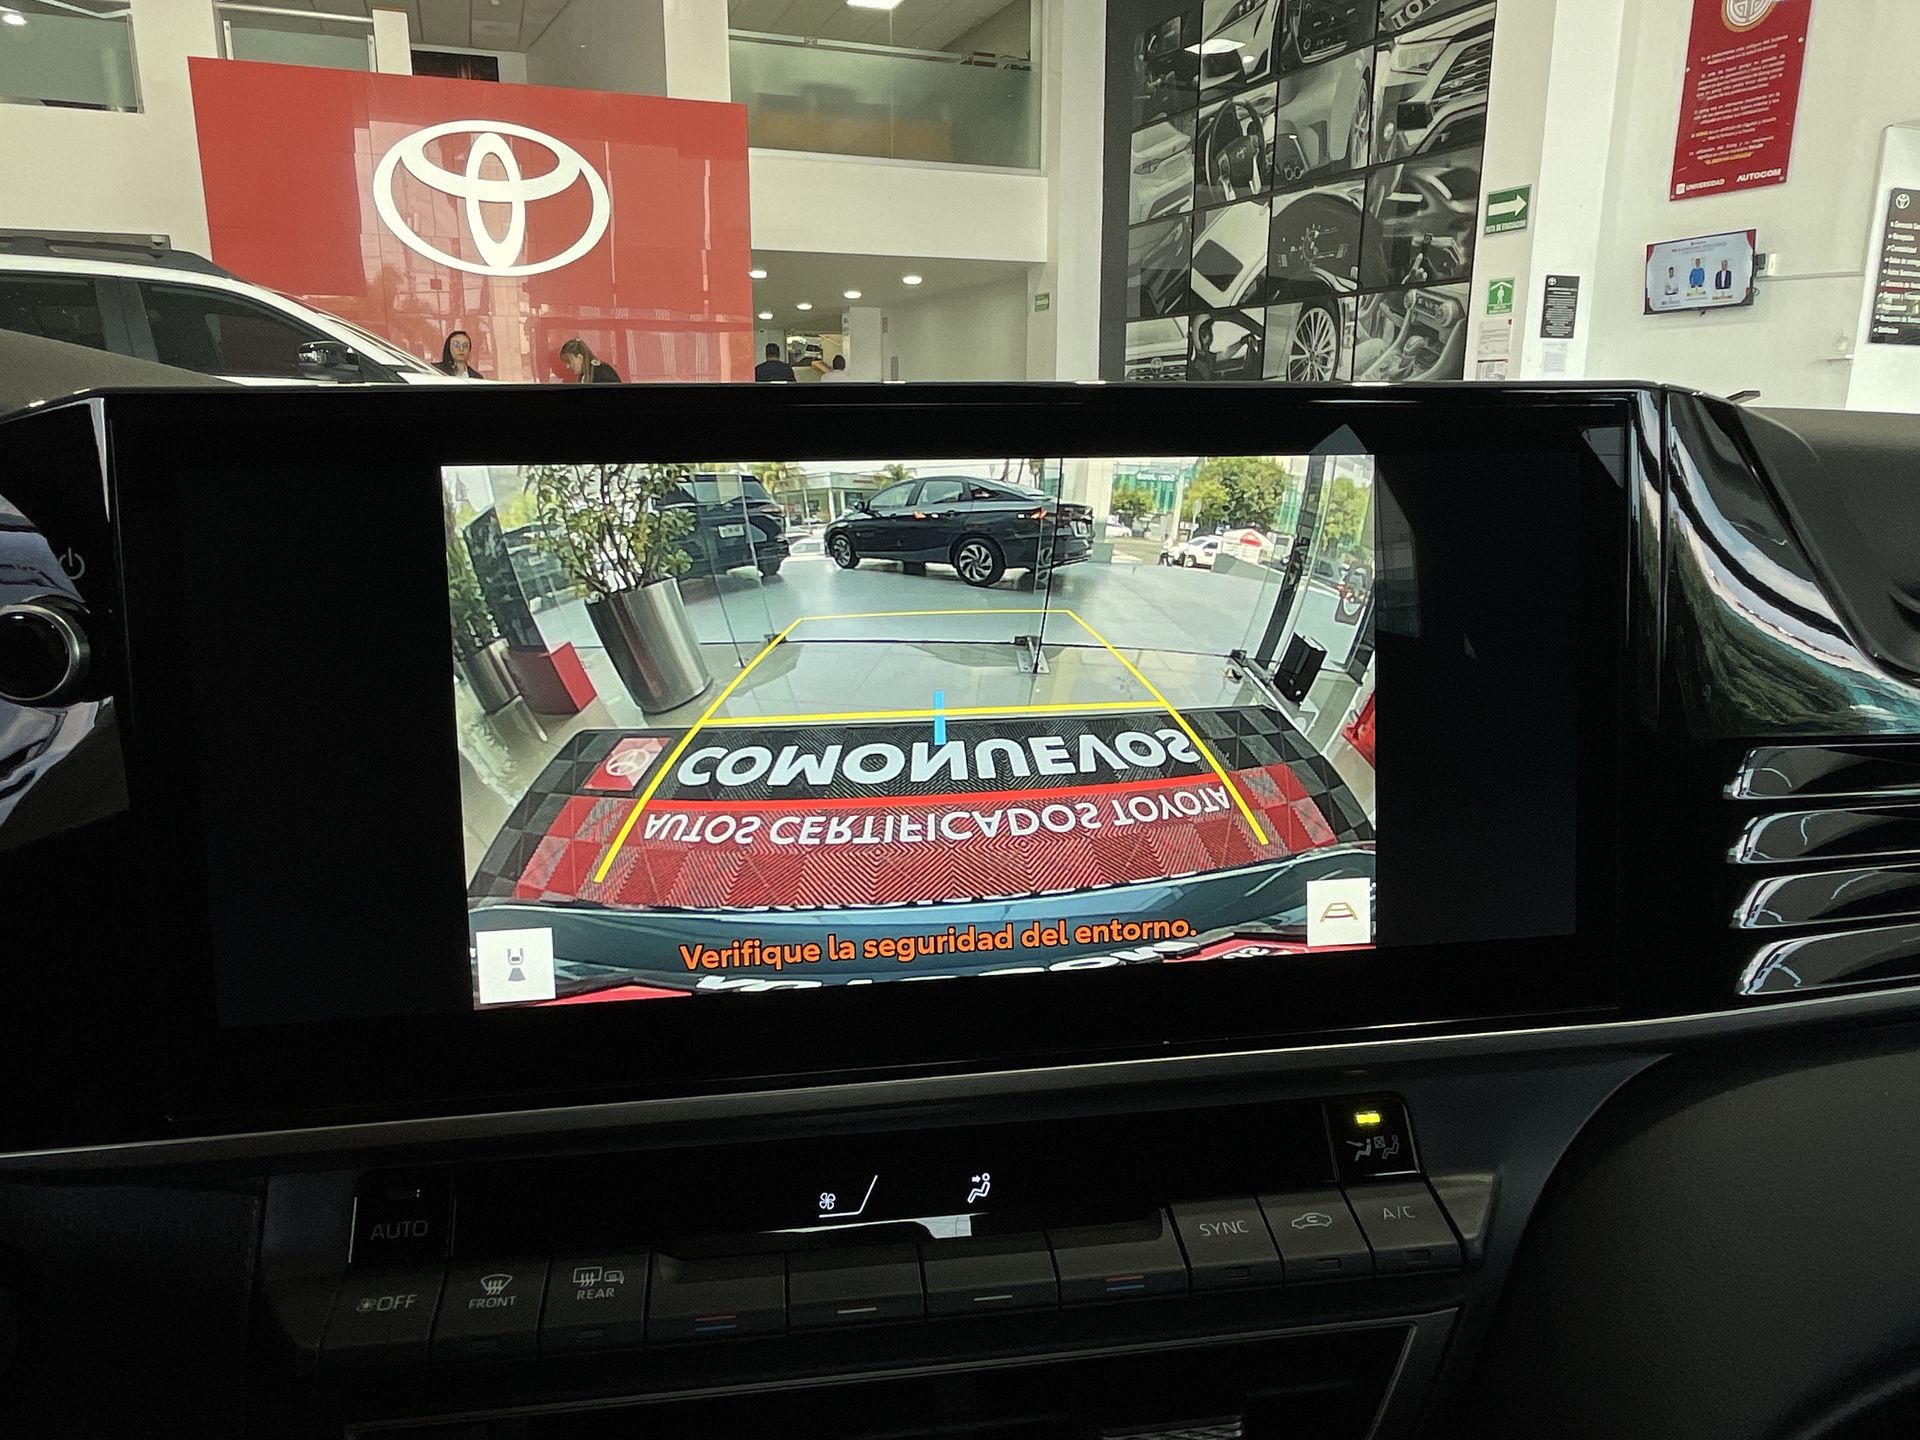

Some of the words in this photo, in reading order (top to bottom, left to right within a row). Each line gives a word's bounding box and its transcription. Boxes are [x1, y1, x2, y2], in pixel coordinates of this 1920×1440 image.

[1736, 168, 1782, 182] AUTOCOM
[679, 939, 821, 971] Verifique
[827, 934, 855, 961] la
[863, 924, 1014, 963] seguridad
[1020, 919, 1068, 947] del
[1073, 917, 1198, 944] entorno.
[1382, 1205, 1415, 1221] A/C
[370, 1219, 429, 1241] AUTO
[1198, 1219, 1249, 1237] SYNC
[576, 1287, 615, 1300] REAR
[376, 1293, 418, 1312] OFF
[467, 1295, 517, 1310] FRONT
